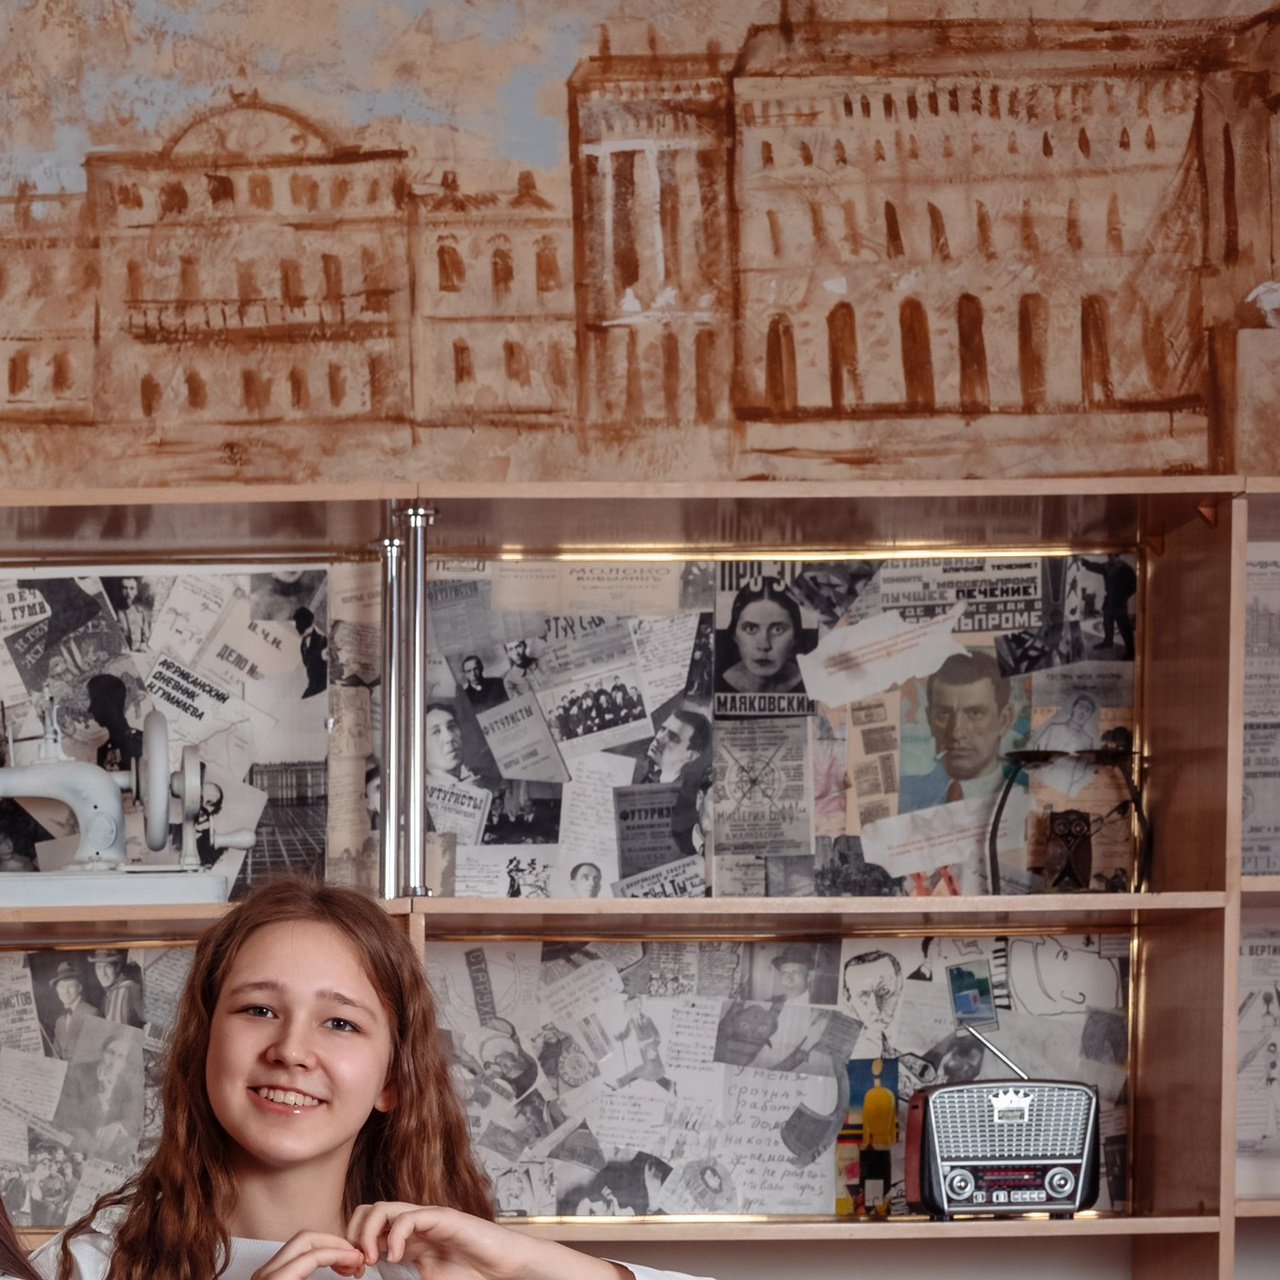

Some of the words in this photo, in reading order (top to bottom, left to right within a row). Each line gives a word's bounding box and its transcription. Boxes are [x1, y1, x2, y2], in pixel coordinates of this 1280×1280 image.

[956, 586, 1038, 599] ПЕЧЕНИЕ!
[216, 644, 248, 671] ДЕЛО
[152, 671, 200, 702] ДНЕВНИК
[158, 659, 230, 704] АФРИКАНСКИЙ
[716, 695, 816, 713] МАЯКОВСКИЙ
[483, 705, 533, 736] ФУТУРИСТЫ
